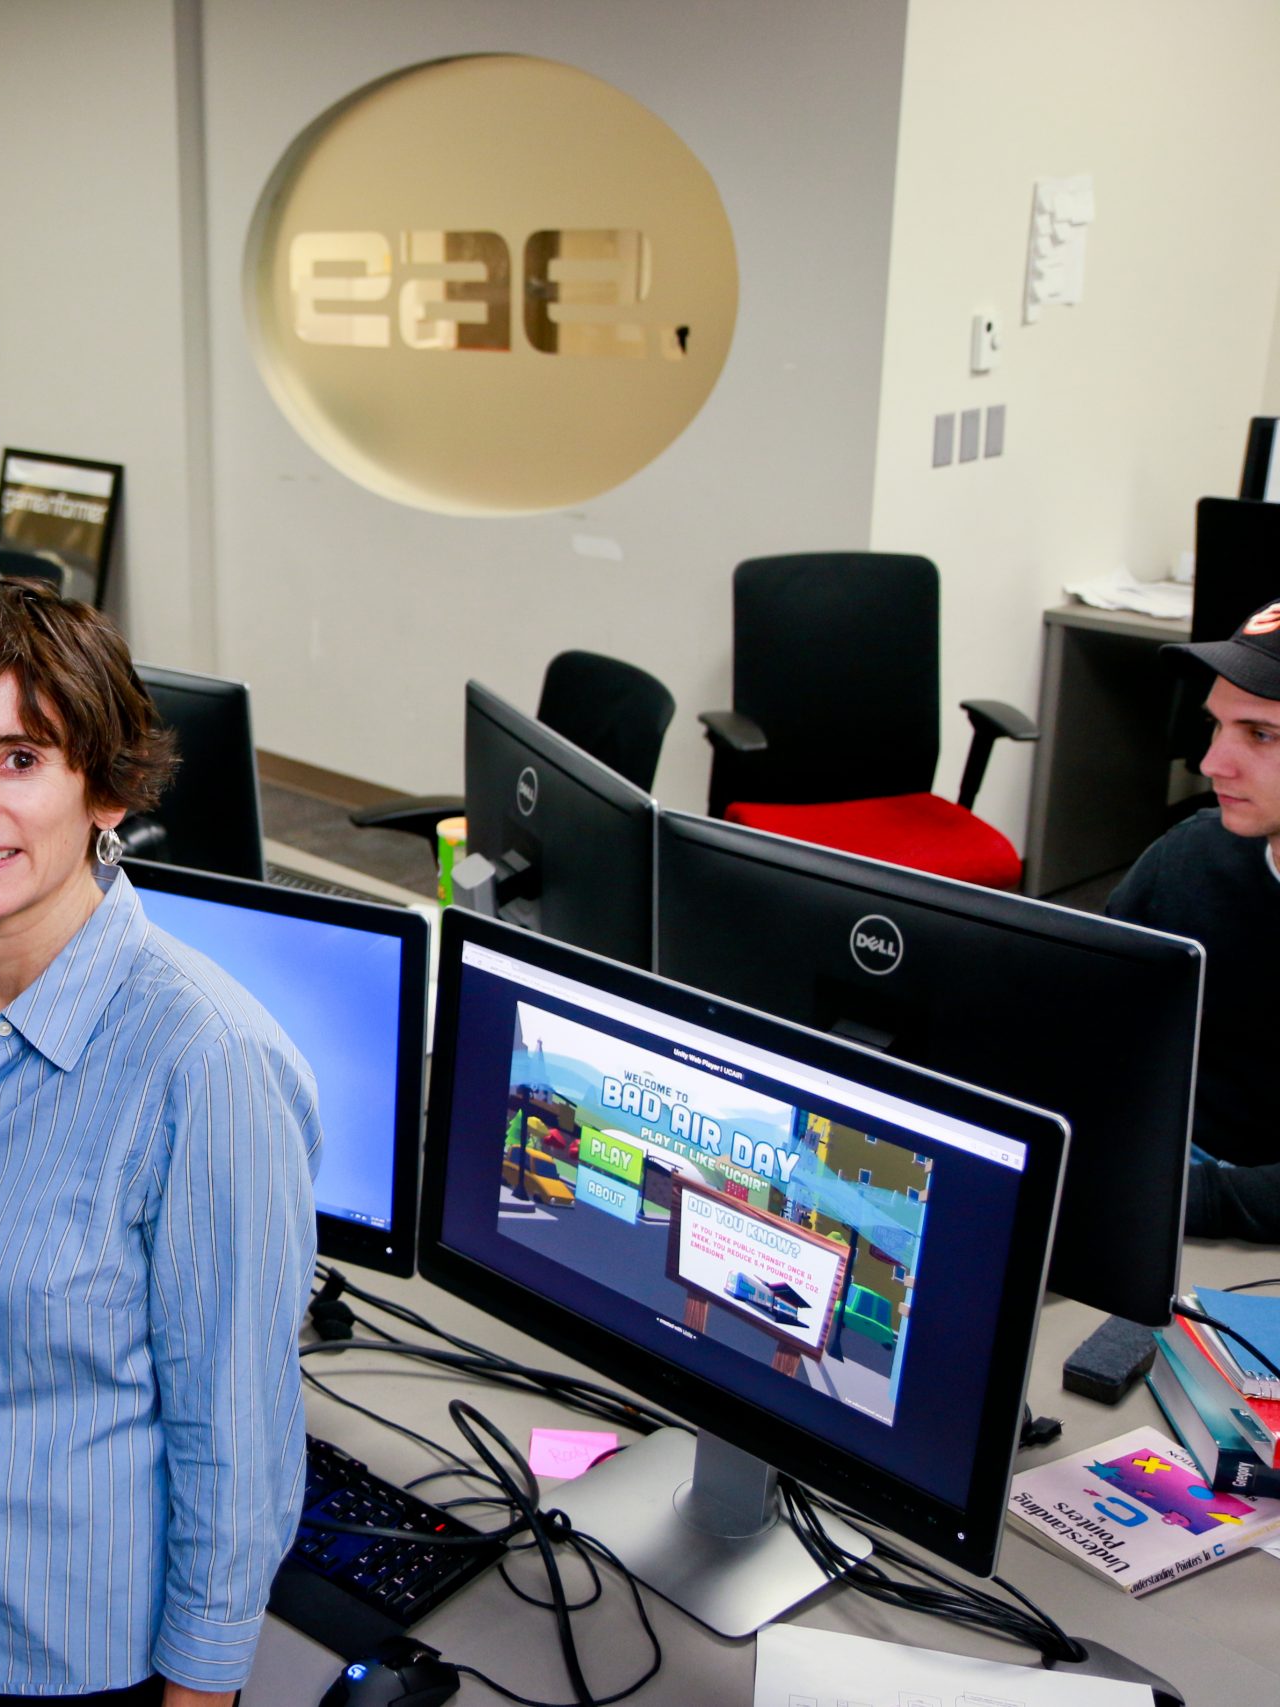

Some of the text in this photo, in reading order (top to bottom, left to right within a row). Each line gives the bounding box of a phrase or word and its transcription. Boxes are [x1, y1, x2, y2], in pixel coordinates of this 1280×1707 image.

[856, 932, 897, 957] DELL
[673, 1048, 688, 1060] Unity
[689, 1054, 702, 1065] Web
[702, 1059, 720, 1071] Player
[624, 1070, 689, 1104] WELCOME TO
[601, 1076, 800, 1183] BAD AIR DAY
[591, 1138, 632, 1171] PLAY
[641, 1127, 670, 1147] PLAY
[673, 1139, 687, 1153] IT
[689, 1148, 717, 1172] LIKE
[588, 1181, 625, 1207] ABOUT
[687, 1195, 801, 1259] DID YOU KNOW?
[690, 1241, 726, 1262] EMISSIONS.
[700, 1225, 713, 1237] YOU
[715, 1231, 731, 1244] TAKE
[733, 1240, 756, 1256] PUBLIC
[758, 1251, 785, 1269] TRANSIT
[787, 1264, 806, 1278] ONCE
[713, 1241, 726, 1252] YOU
[727, 1246, 752, 1264] REDUCE
[754, 1260, 764, 1269] 5.4
[767, 1265, 793, 1283] POUNDS
[794, 1277, 804, 1286] OF
[805, 1282, 819, 1294] CO2
[1232, 1461, 1255, 1488] Gregory
[1053, 1502, 1126, 1550] Pointers
[1093, 1496, 1149, 1528] C
[1010, 1491, 1131, 1574] Understanding
[1176, 1555, 1202, 1574] Pointers
[1202, 1550, 1211, 1562] In
[1213, 1543, 1226, 1557] C
